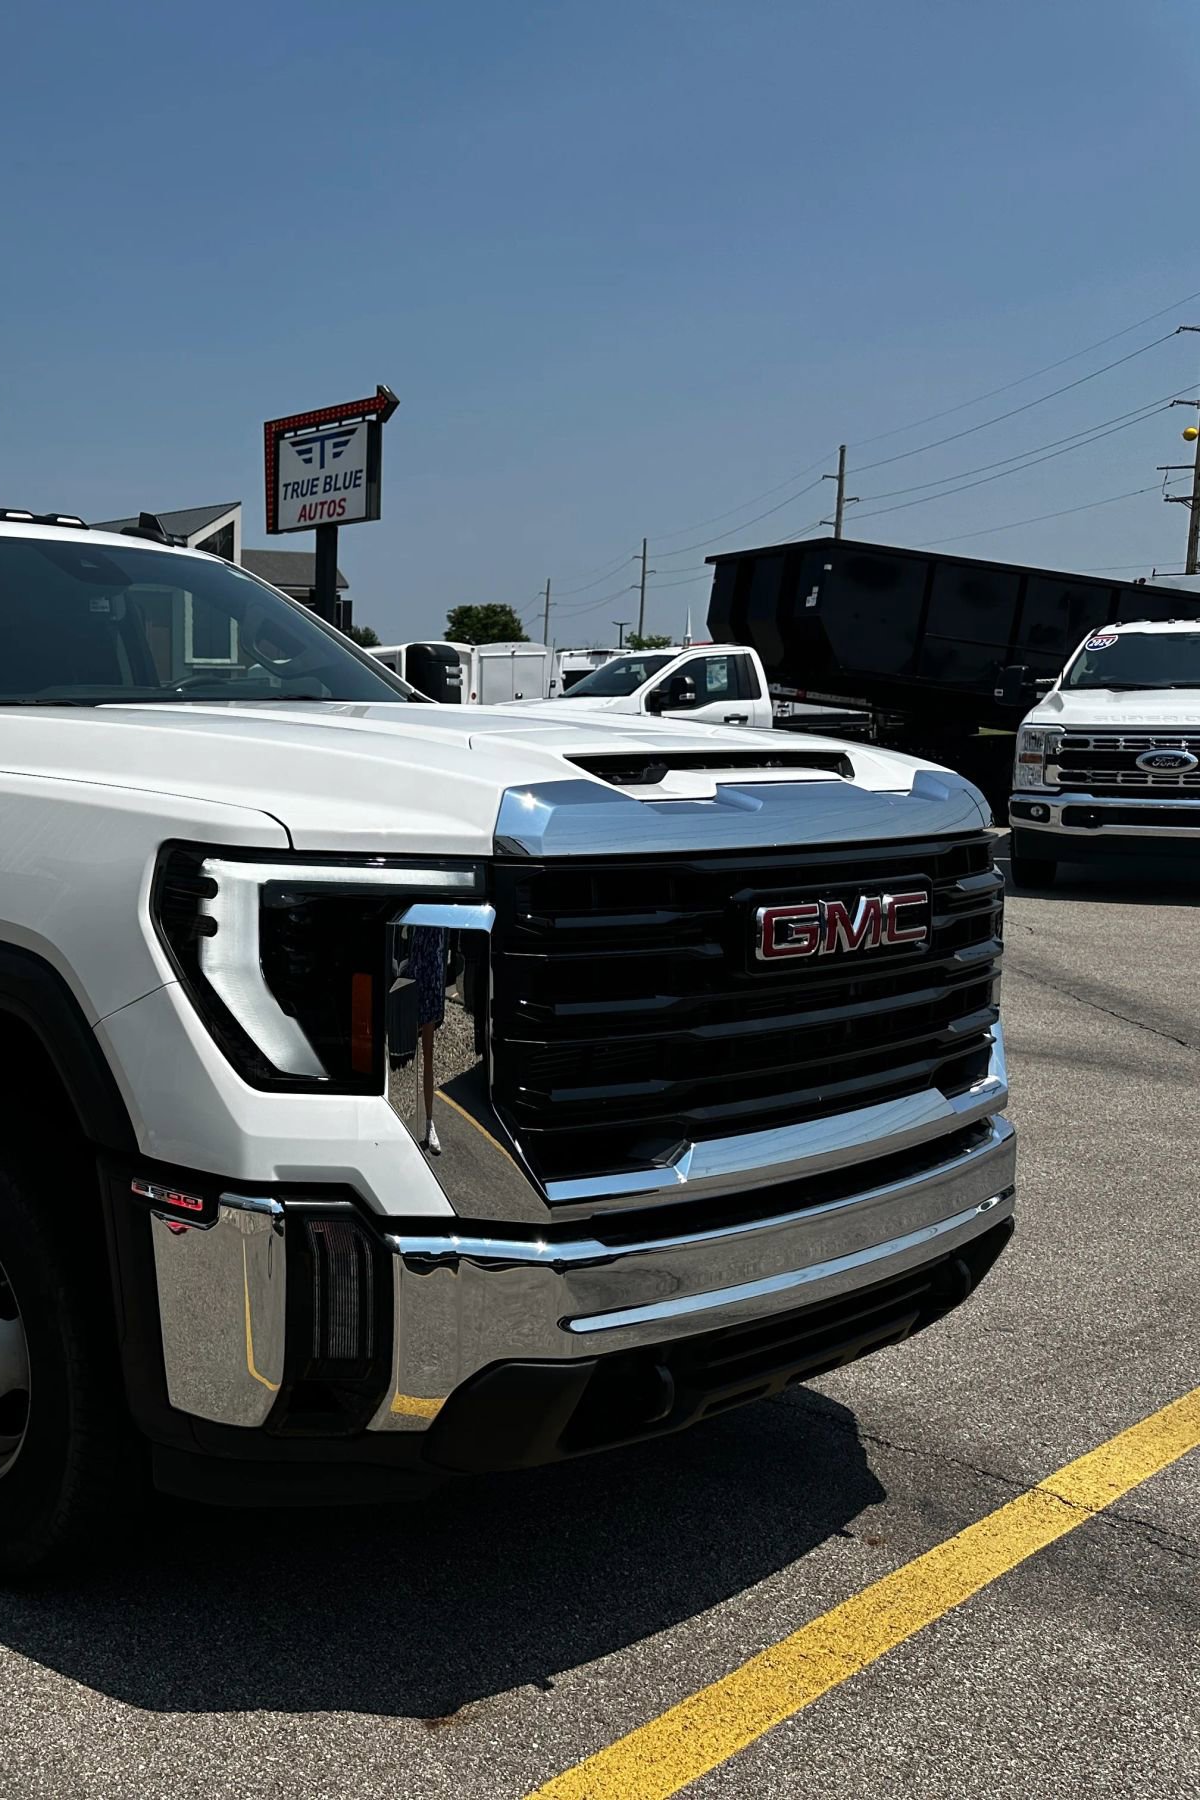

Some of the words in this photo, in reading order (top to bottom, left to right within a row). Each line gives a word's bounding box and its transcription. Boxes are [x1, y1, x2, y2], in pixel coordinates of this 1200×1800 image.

[282, 477, 320, 500] TRUE
[323, 469, 363, 494] BLUE
[297, 498, 347, 523] AUTOS
[1088, 637, 1112, 648] 2024
[1152, 756, 1182, 768] Ford
[756, 891, 928, 961] GMC
